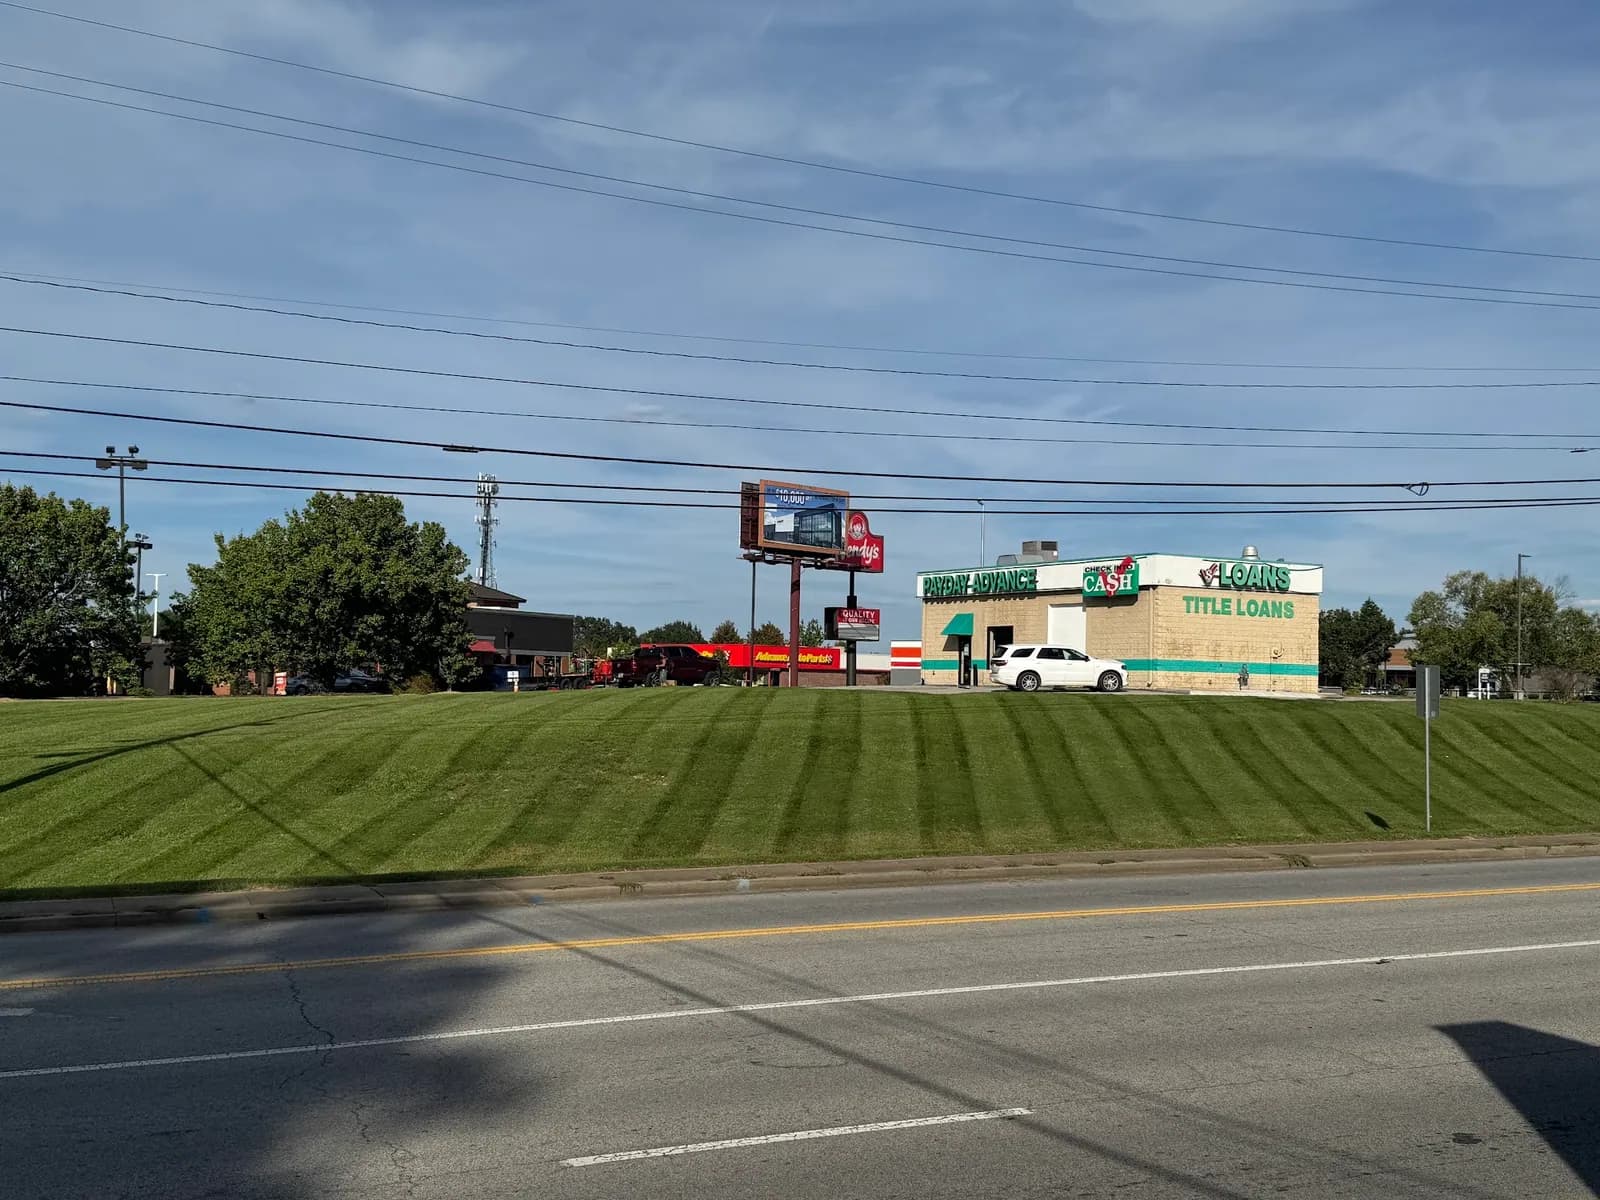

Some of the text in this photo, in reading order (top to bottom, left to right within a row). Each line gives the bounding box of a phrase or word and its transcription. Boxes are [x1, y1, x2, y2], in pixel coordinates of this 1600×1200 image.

[847, 538, 880, 564] endy's
[1084, 565, 1112, 573] CHECK
[1219, 562, 1291, 592] LOANS
[922, 568, 1038, 597] PAYDAY ADVANCE
[842, 609, 876, 619] QUALITY
[1183, 596, 1295, 619] TITLE LOANS
